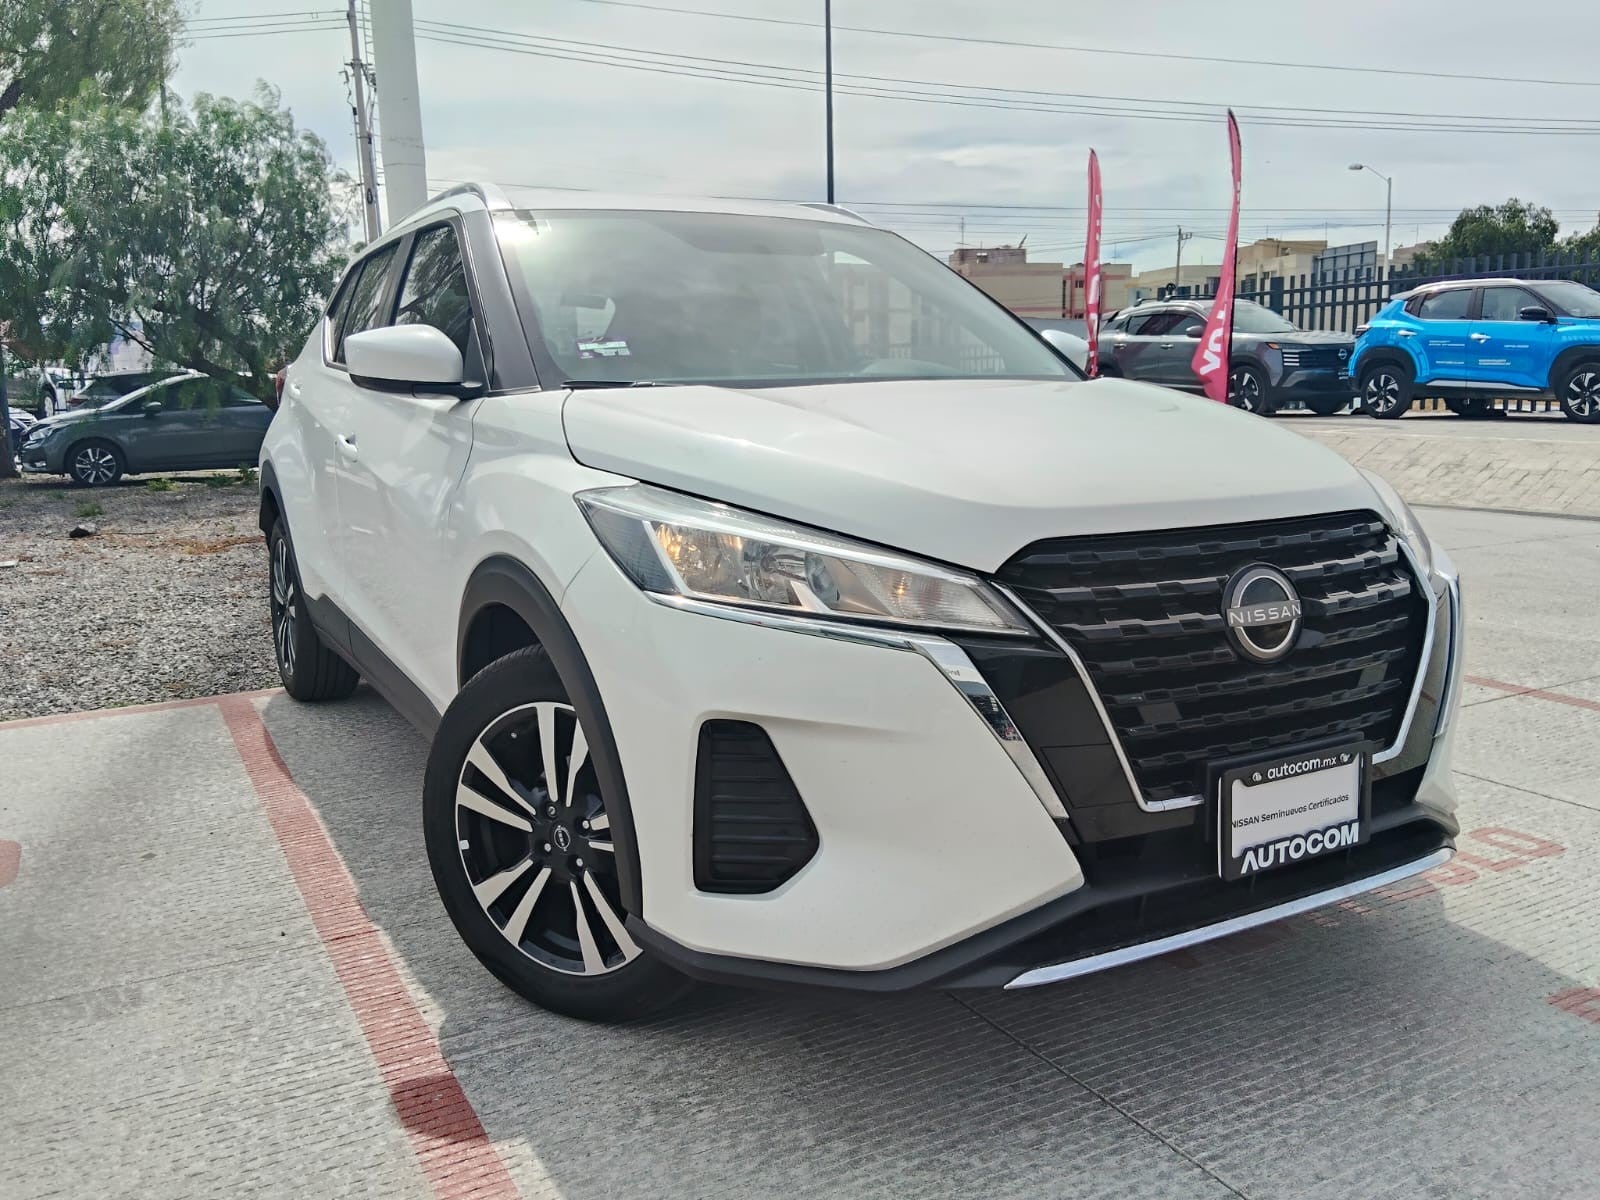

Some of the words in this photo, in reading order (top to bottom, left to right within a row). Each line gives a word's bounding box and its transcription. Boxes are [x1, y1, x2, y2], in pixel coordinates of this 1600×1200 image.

[1229, 603, 1301, 625] NISSAN
[1267, 755, 1337, 780] autocom.mx
[1261, 805, 1307, 822] Seminuevos
[1308, 794, 1349, 811] Certificados
[1240, 822, 1360, 874] AUTOCOM
